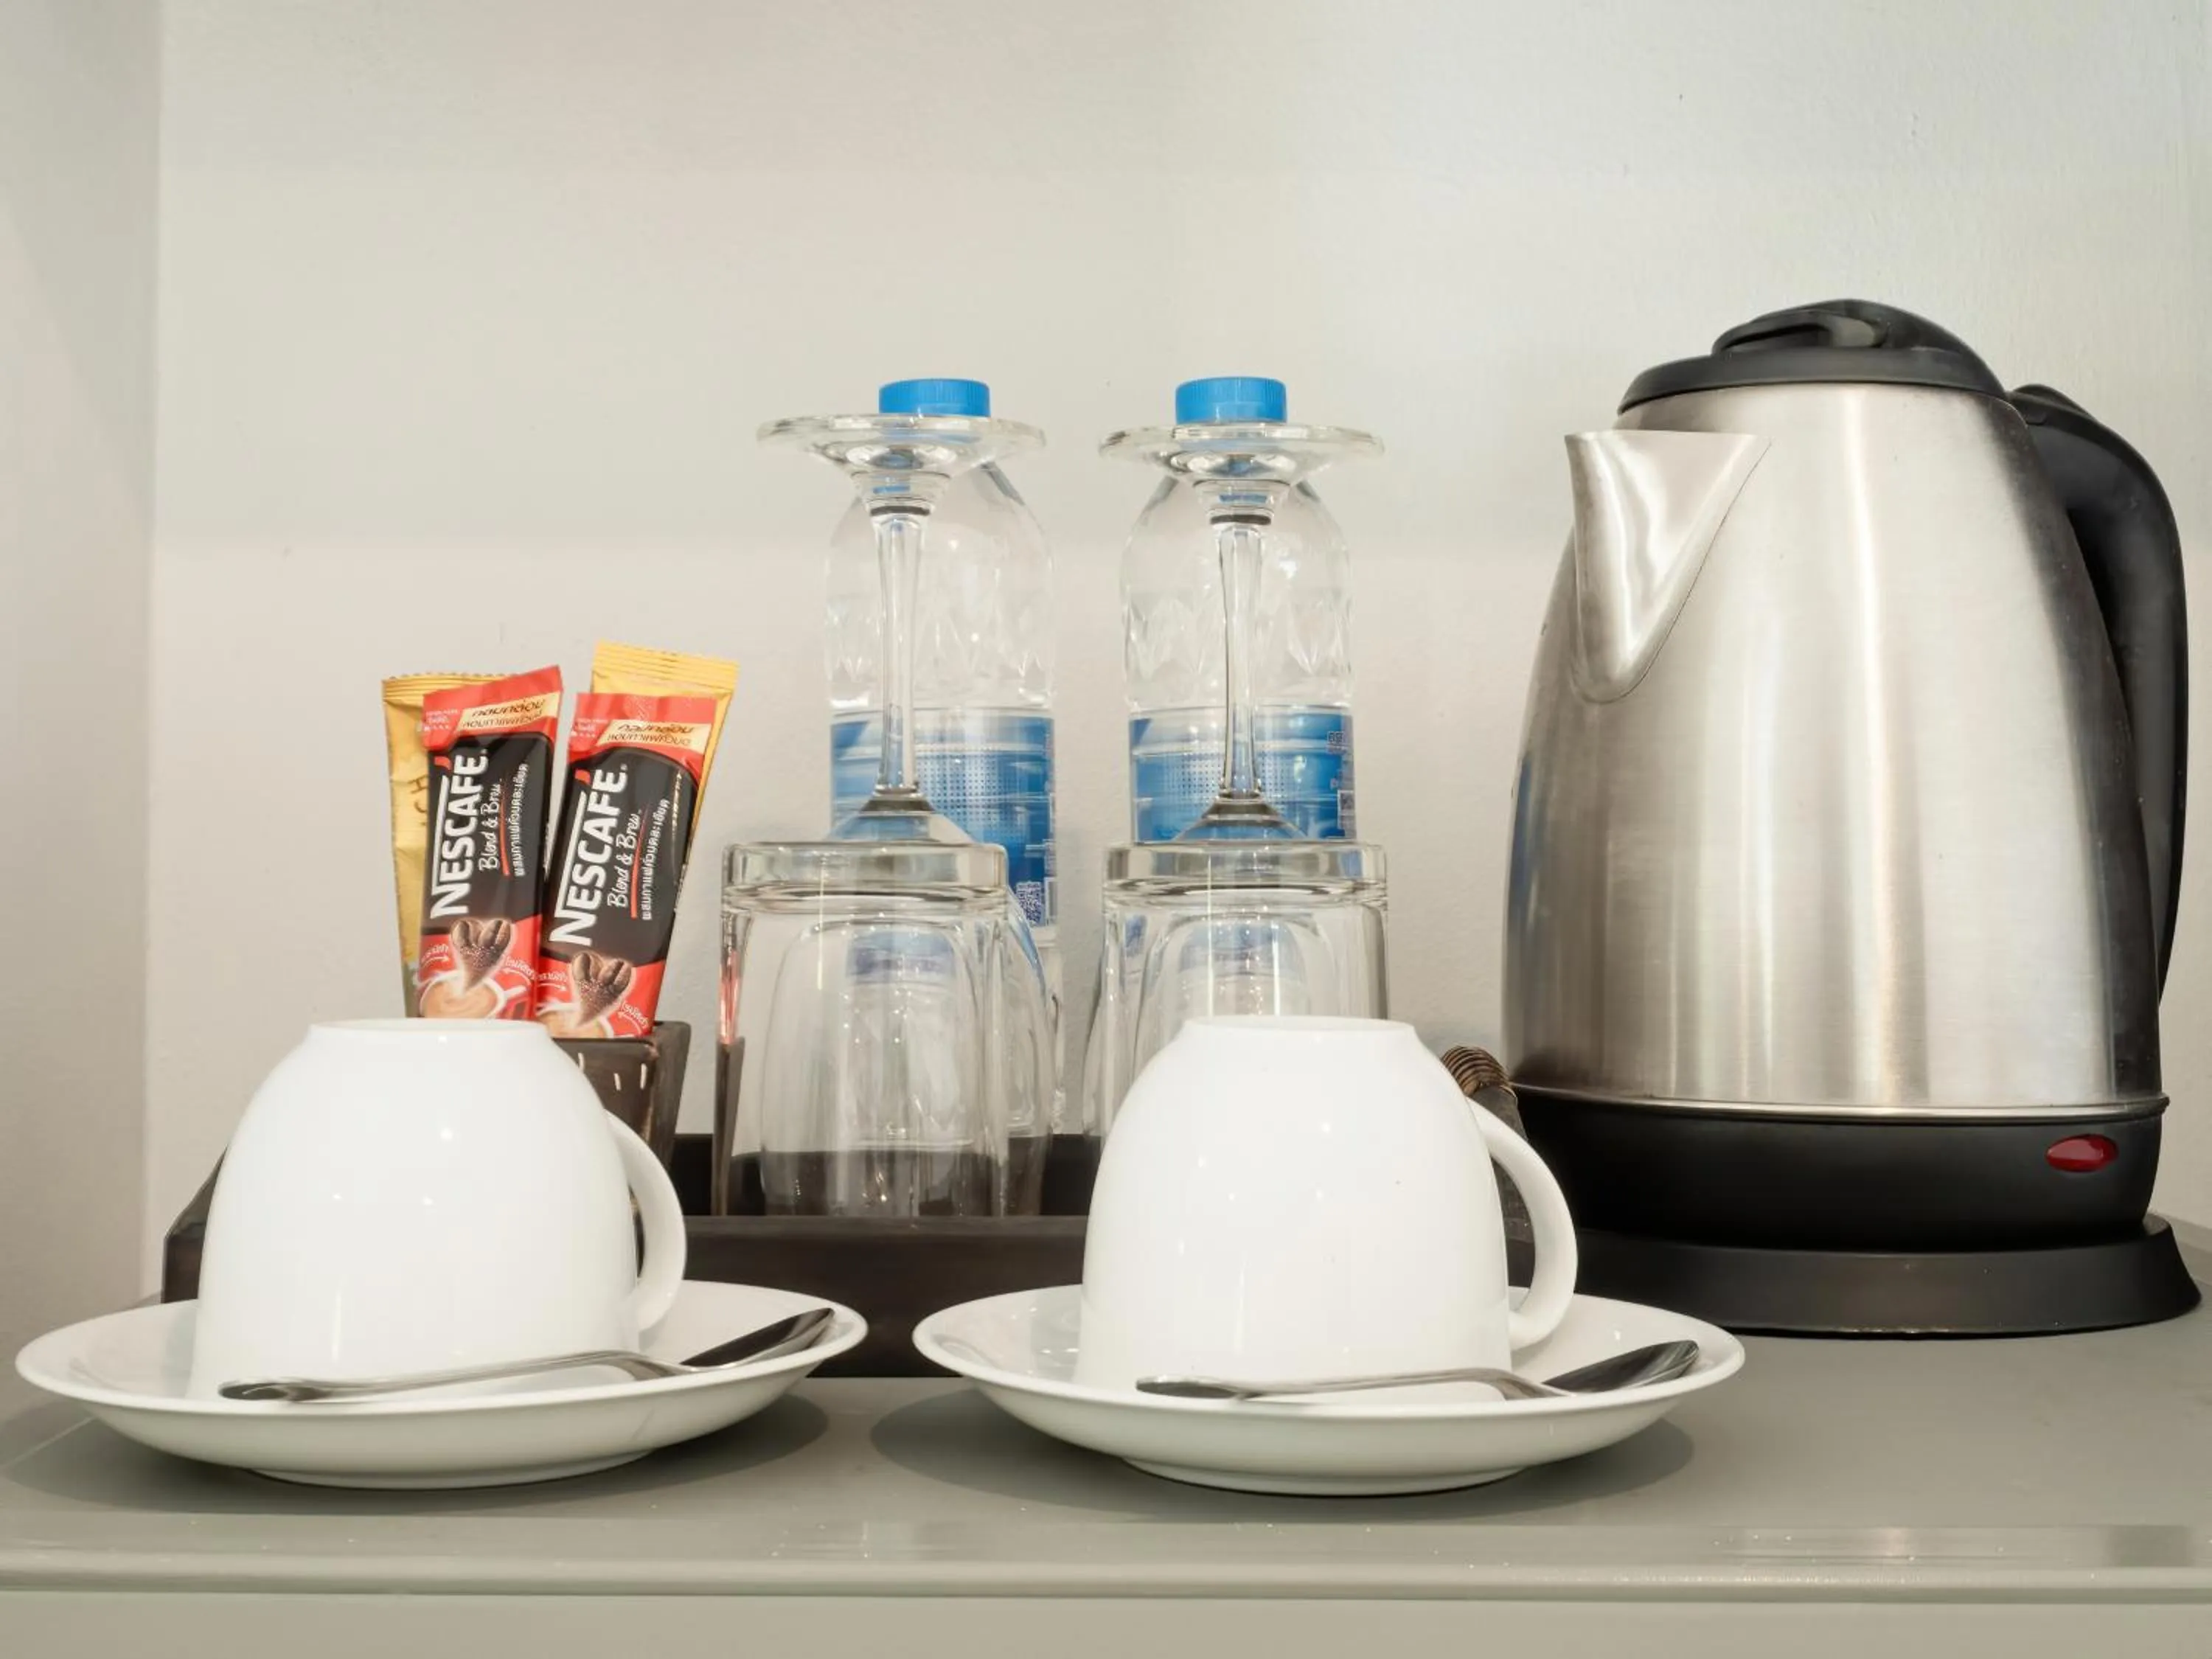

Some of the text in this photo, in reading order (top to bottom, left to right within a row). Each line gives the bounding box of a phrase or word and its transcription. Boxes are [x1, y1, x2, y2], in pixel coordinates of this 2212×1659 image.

[481, 815, 498, 828] &
[479, 831, 500, 871] Blend
[607, 813, 641, 908] Blend & Brew
